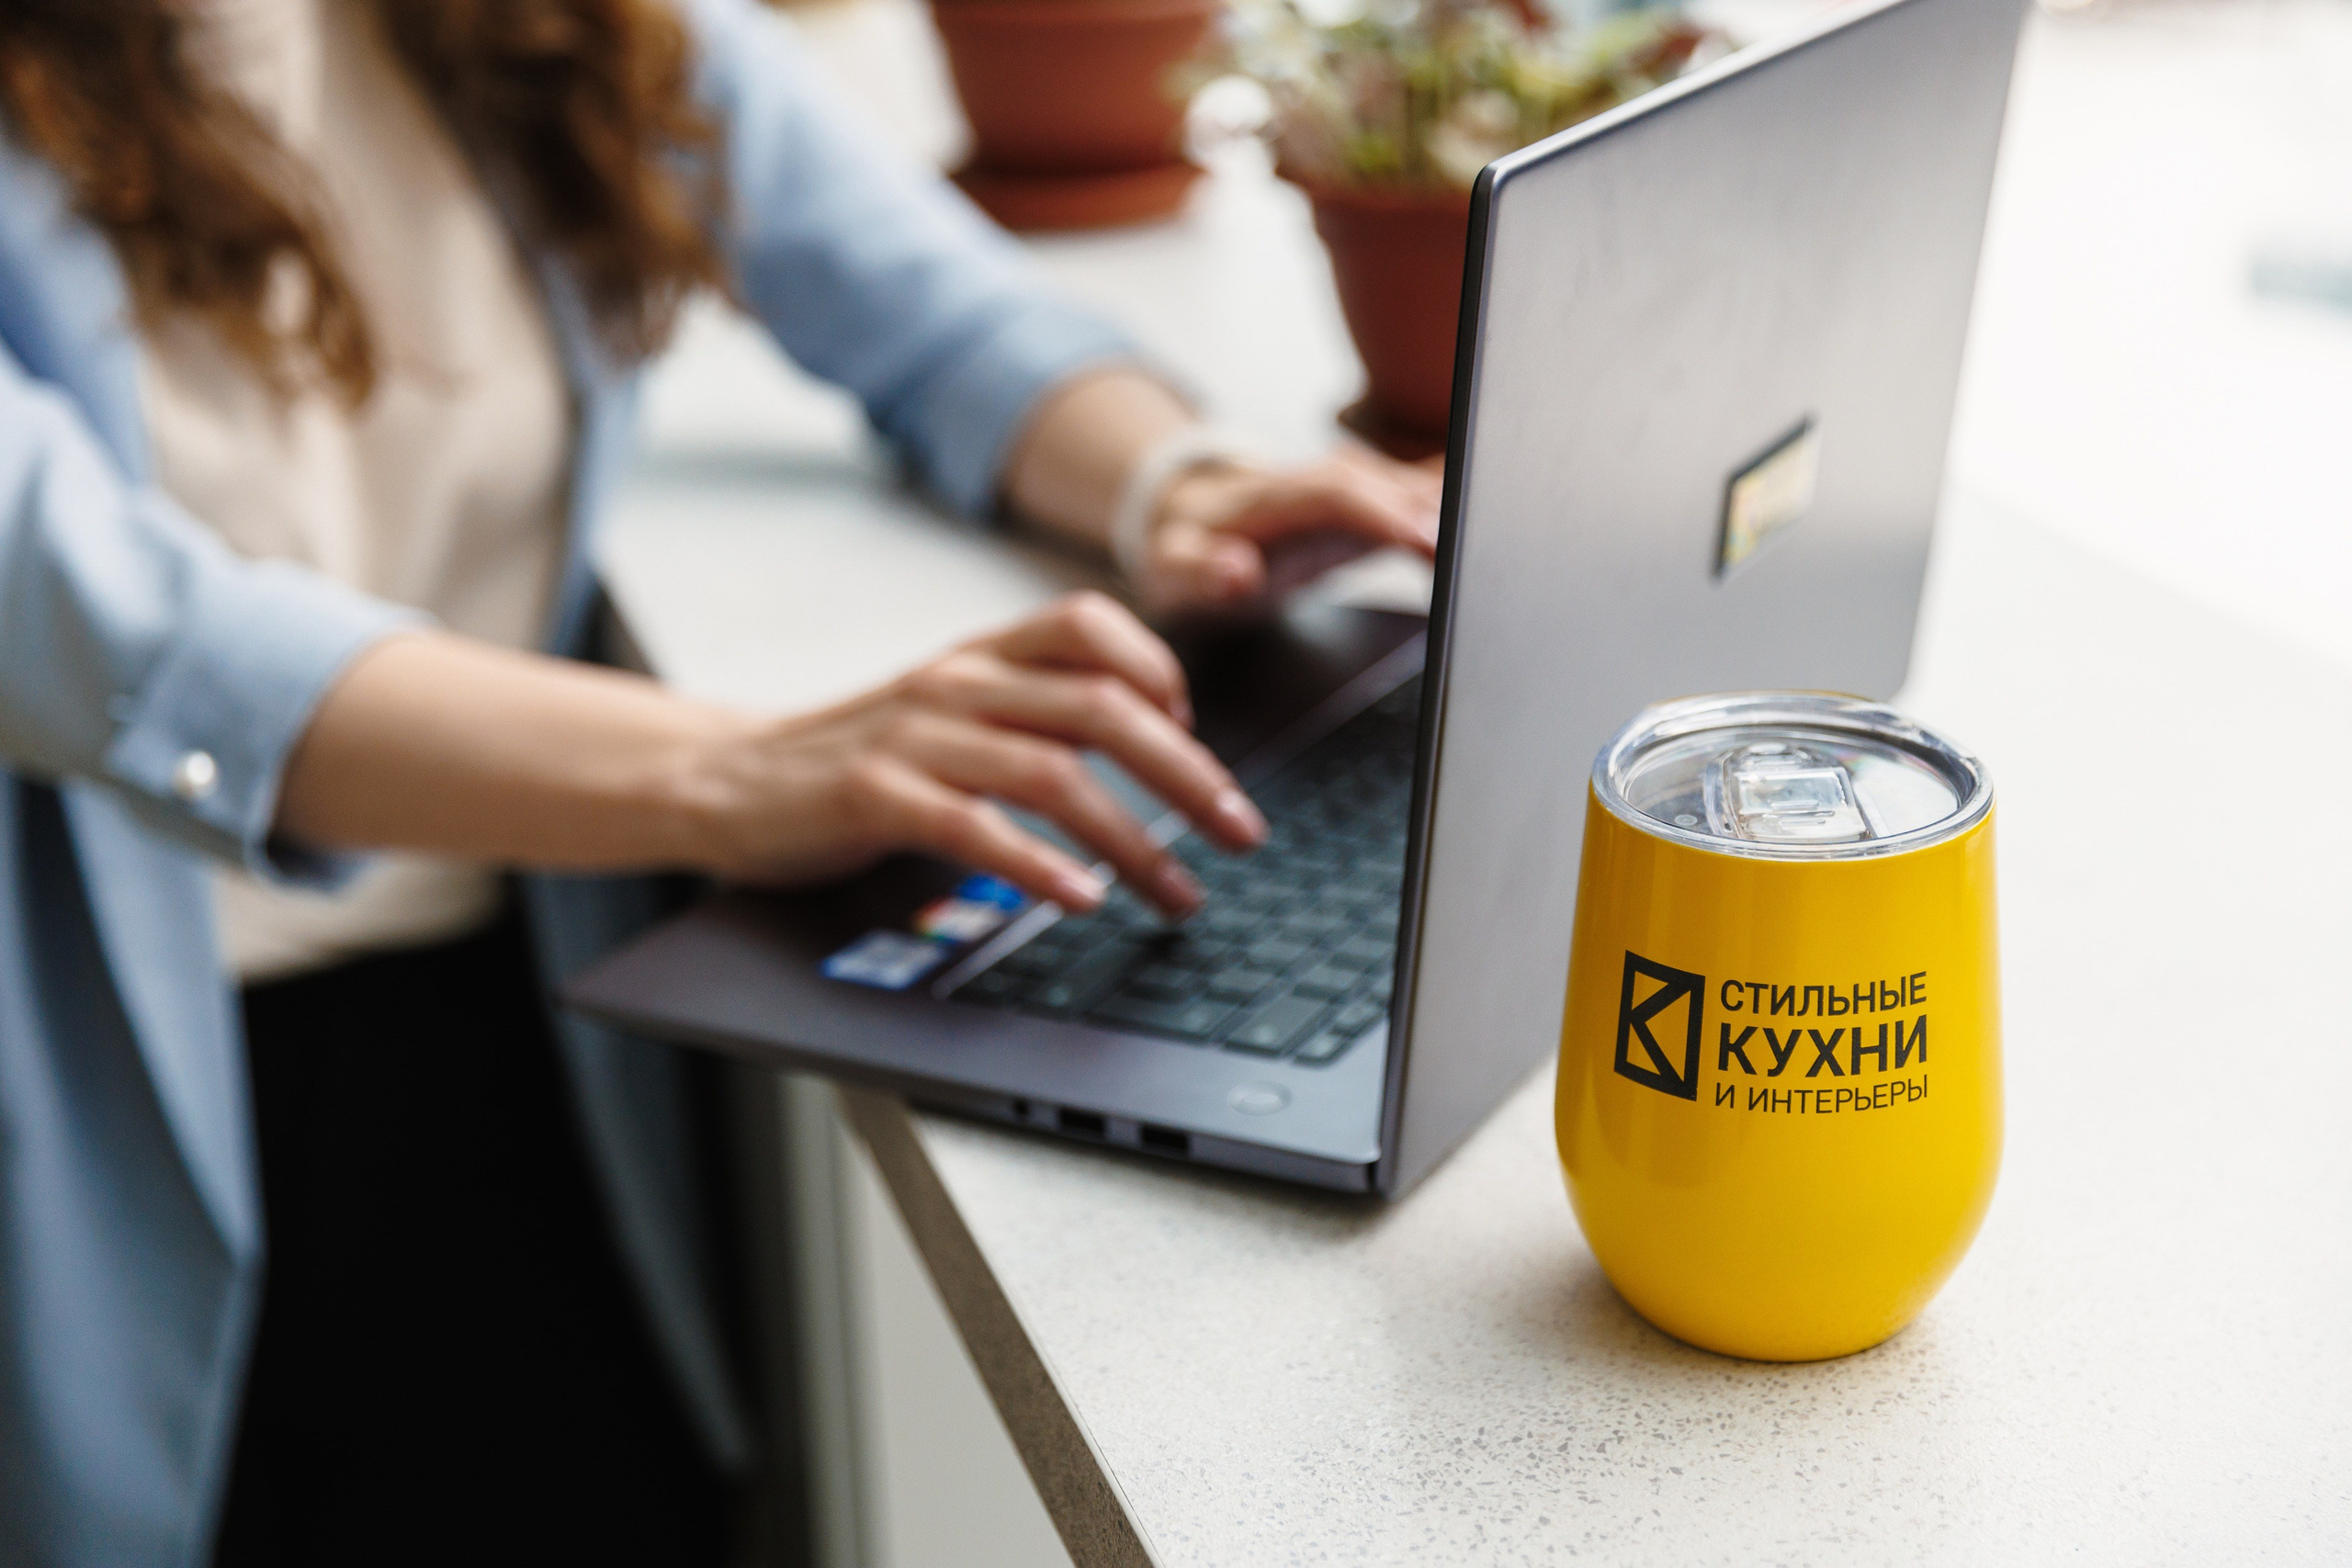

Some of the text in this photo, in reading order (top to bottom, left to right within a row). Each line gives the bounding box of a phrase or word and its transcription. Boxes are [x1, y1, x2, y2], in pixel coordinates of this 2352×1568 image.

[1720, 971, 1928, 1017] СТИЛЬНЫЕ
[1717, 1014, 1928, 1078] КУХНИ
[1714, 1074, 1928, 1114] И ИНТЕРЬЕРЫ
